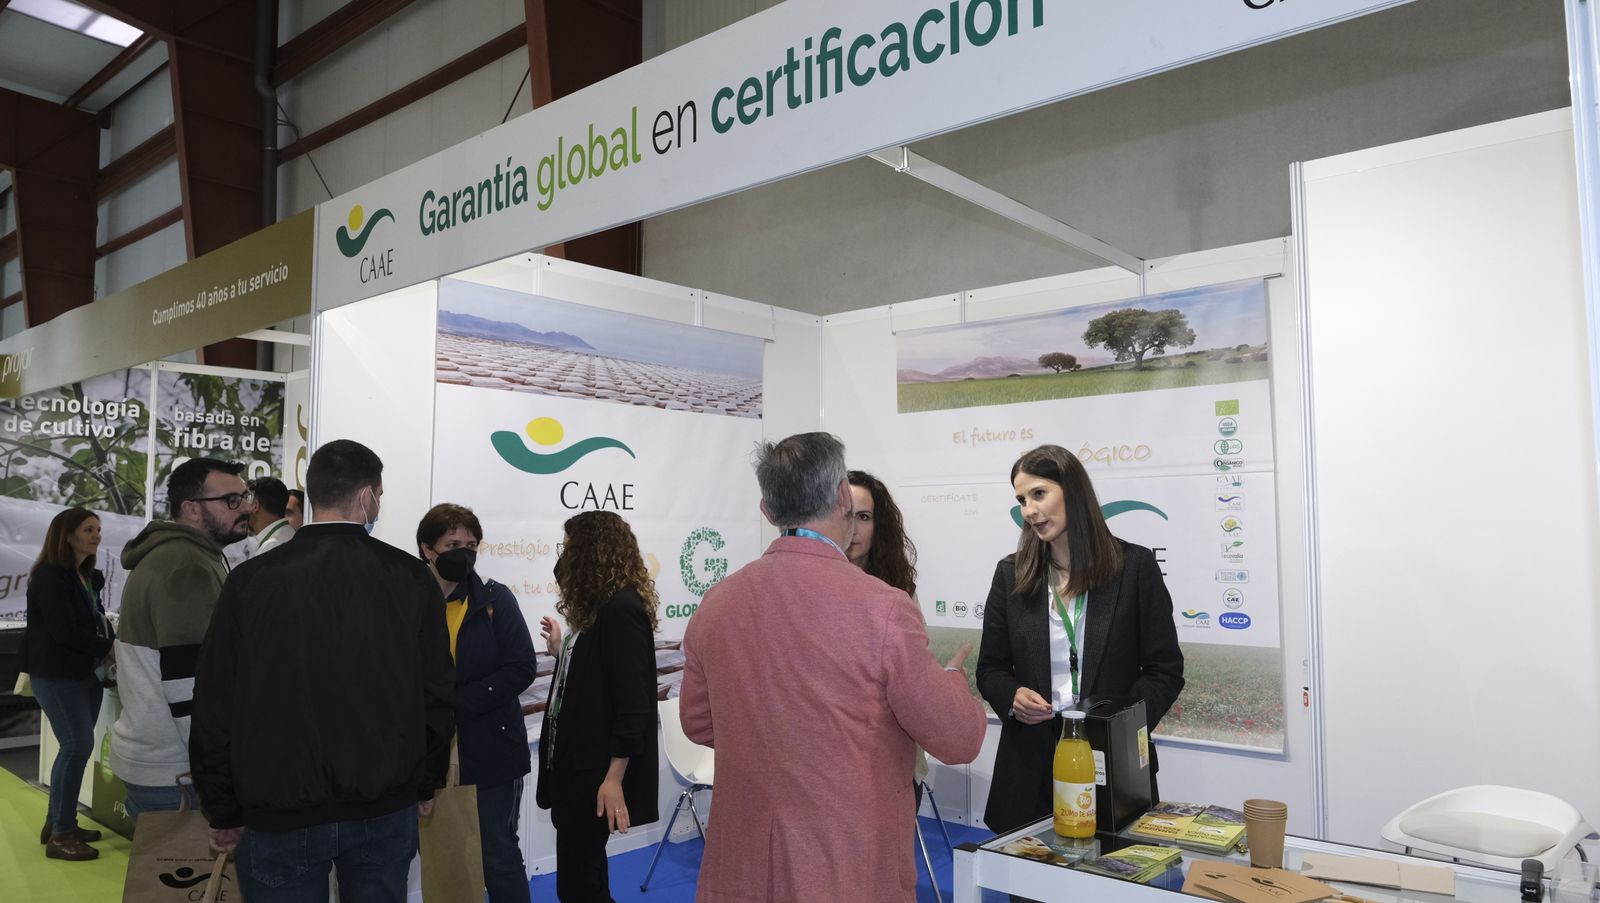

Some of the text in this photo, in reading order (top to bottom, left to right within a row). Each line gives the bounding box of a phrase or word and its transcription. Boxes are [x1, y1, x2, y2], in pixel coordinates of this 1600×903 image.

[419, 156, 529, 237] Garantía
[536, 106, 642, 211] global
[651, 99, 698, 155] en
[359, 248, 394, 284] CAAE
[152, 262, 289, 326] Cumplimos 40 años a tu servicio
[2, 346, 35, 382] projar
[4, 415, 116, 438] de cultivo
[174, 407, 260, 427] basada en
[172, 427, 271, 453] fibra de
[952, 427, 1034, 447] El futuro es
[1077, 441, 1153, 466] ÓGICO
[560, 480, 635, 511] CAAE
[479, 539, 550, 561] Prestigio
[1221, 616, 1249, 624] HACCP
